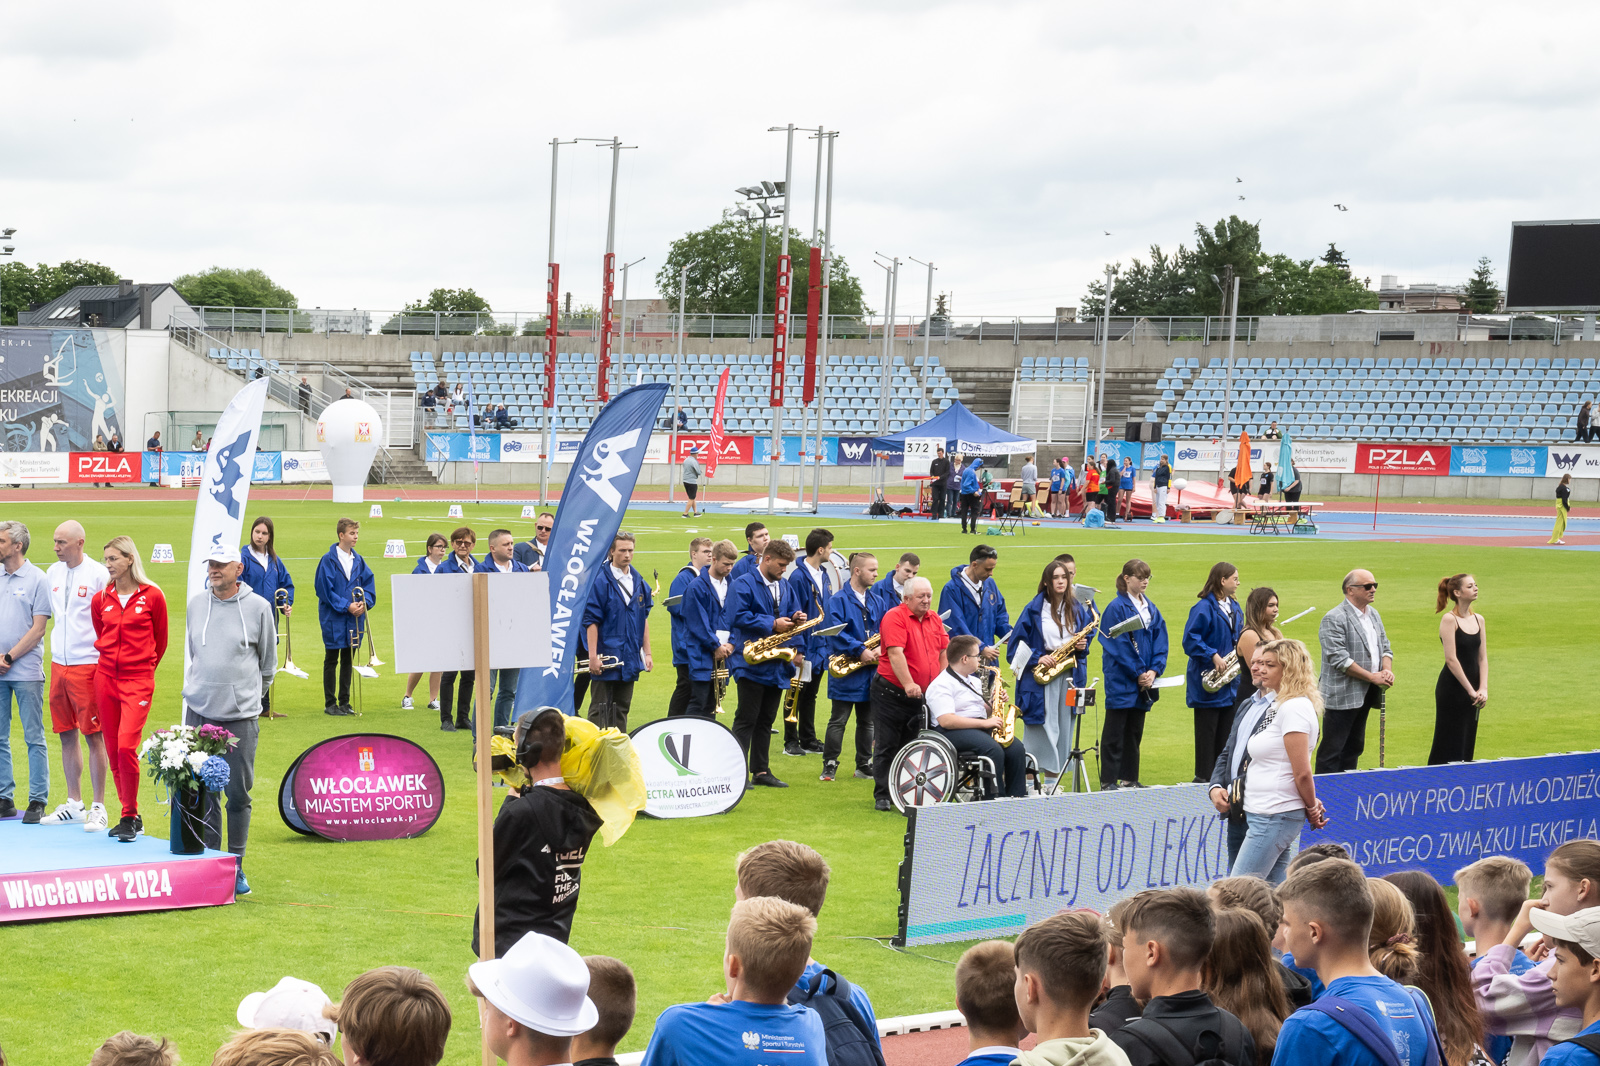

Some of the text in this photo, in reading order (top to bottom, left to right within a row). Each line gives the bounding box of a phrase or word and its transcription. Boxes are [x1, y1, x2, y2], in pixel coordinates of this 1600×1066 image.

[680, 440, 741, 455] PZA
[1369, 449, 1436, 466] PZLA
[78, 457, 132, 473] PZLA
[542, 518, 599, 679] WŁOCŁAWEK
[309, 774, 427, 795] WŁOCŁAWEK
[647, 783, 732, 800] ECTRA WŁOCŁAWEK
[305, 797, 373, 813] MIASTEM
[375, 793, 433, 811] SPORTU
[1355, 789, 1421, 821] NOWY
[1424, 782, 1505, 815] PROJEKT
[326, 813, 418, 825] www.wloclawek.pl
[1340, 834, 1433, 866] OLSKIEGO
[1436, 825, 1516, 859] ZWIĄZKU
[957, 814, 1225, 908] ZACZNIJ OD LEKKI
[2, 873, 121, 909] Włocławek
[122, 868, 173, 899] 2024
